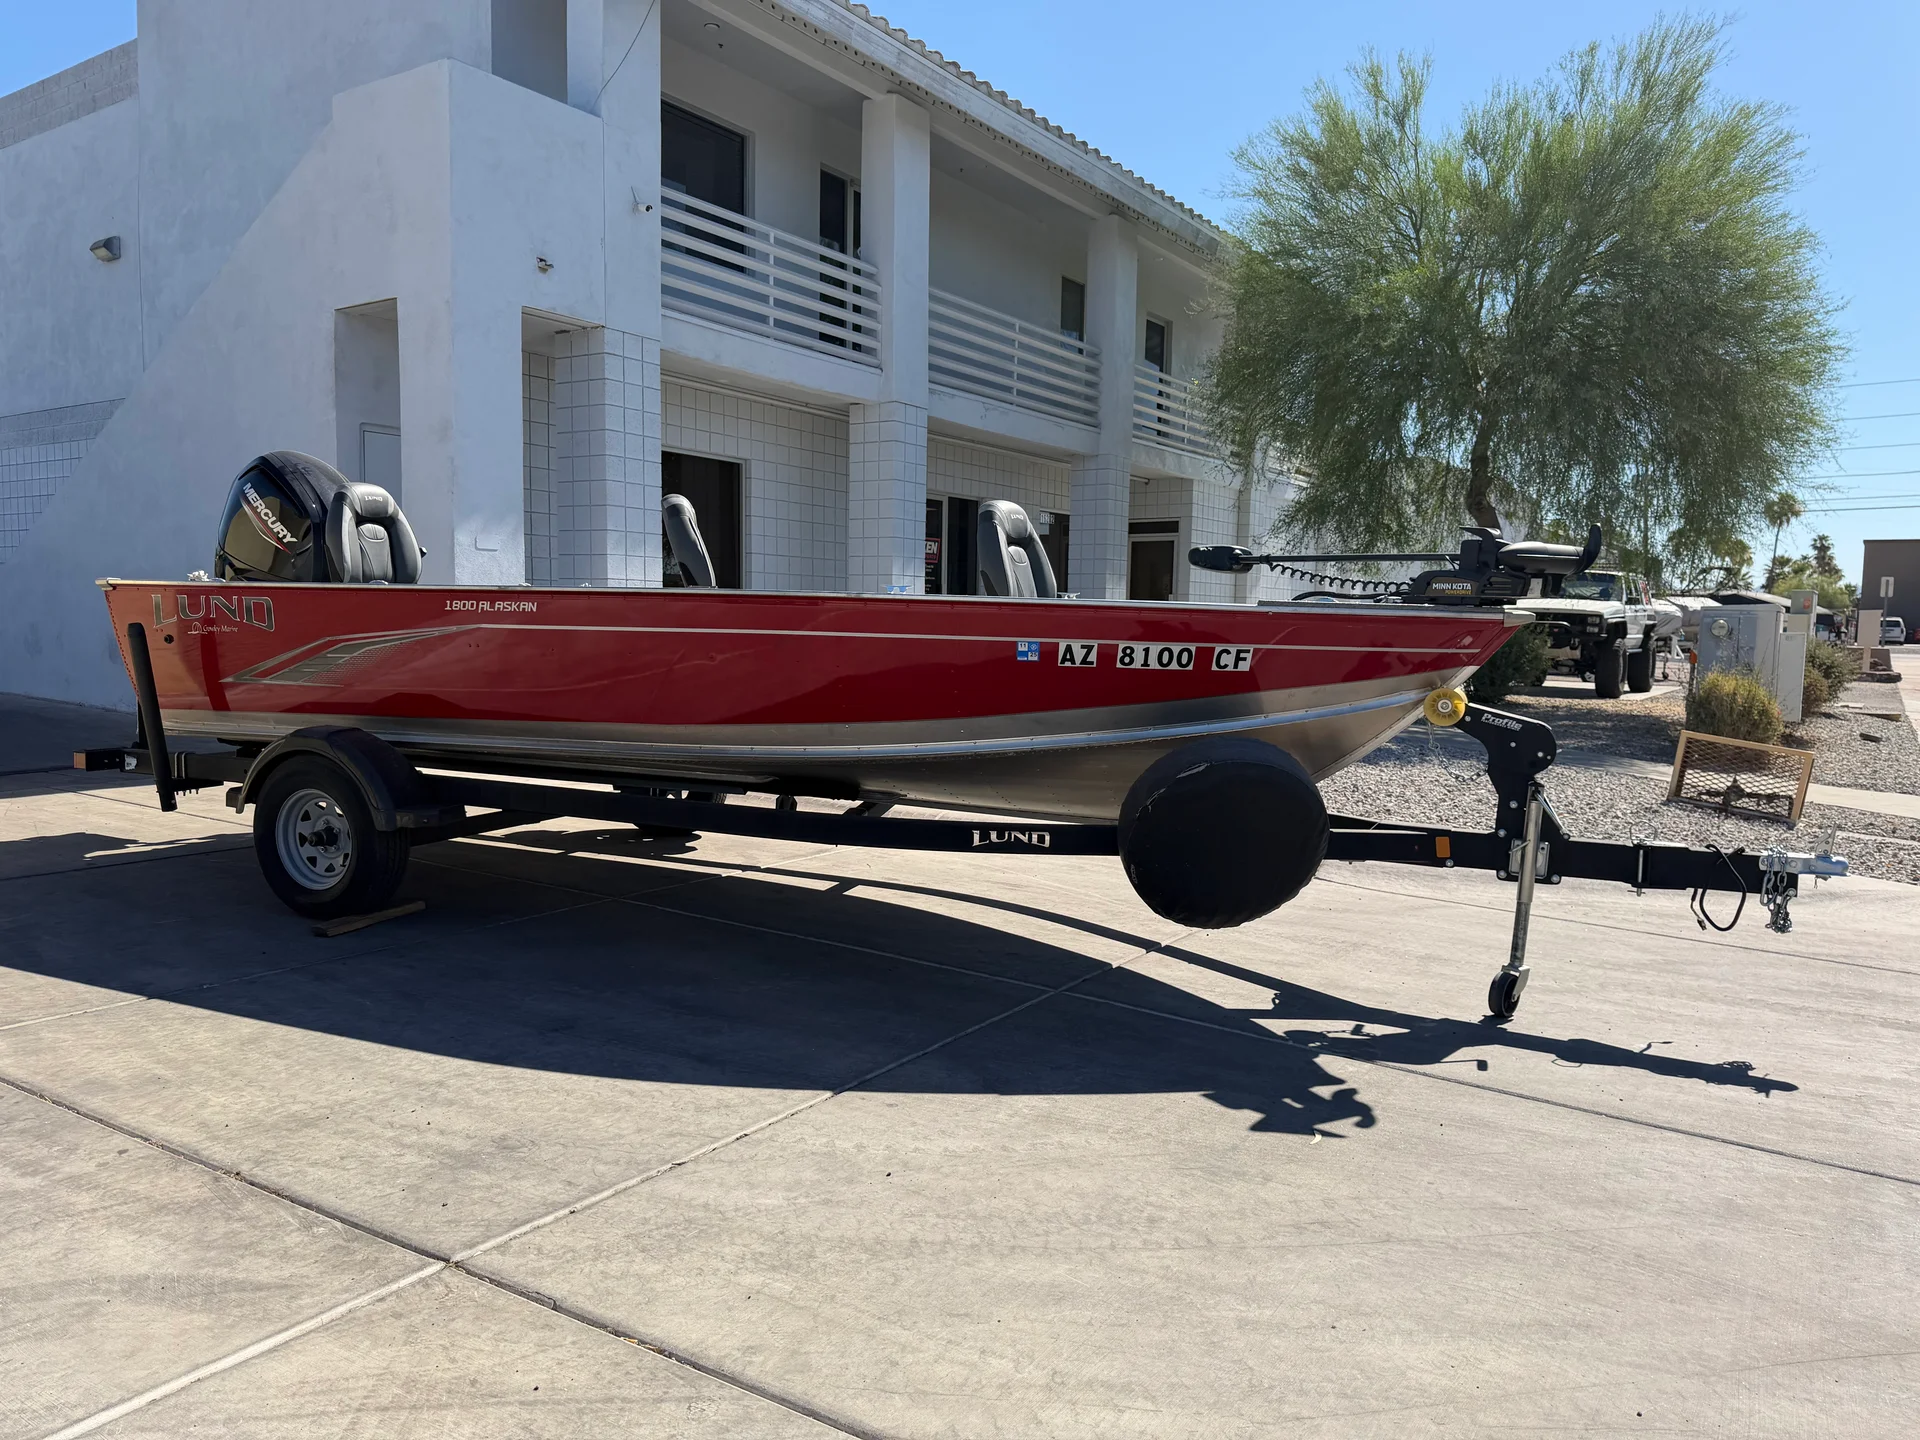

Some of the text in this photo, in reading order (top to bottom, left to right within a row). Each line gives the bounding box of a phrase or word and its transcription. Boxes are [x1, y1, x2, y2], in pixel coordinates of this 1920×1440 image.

[243, 483, 298, 544] MERCURY
[151, 594, 275, 632] LUND
[445, 600, 537, 613] 1800 ALASKAN
[1059, 644, 1250, 669] AZ 8100 CF
[1481, 713, 1523, 729] Profile
[972, 830, 1051, 848] LUND
